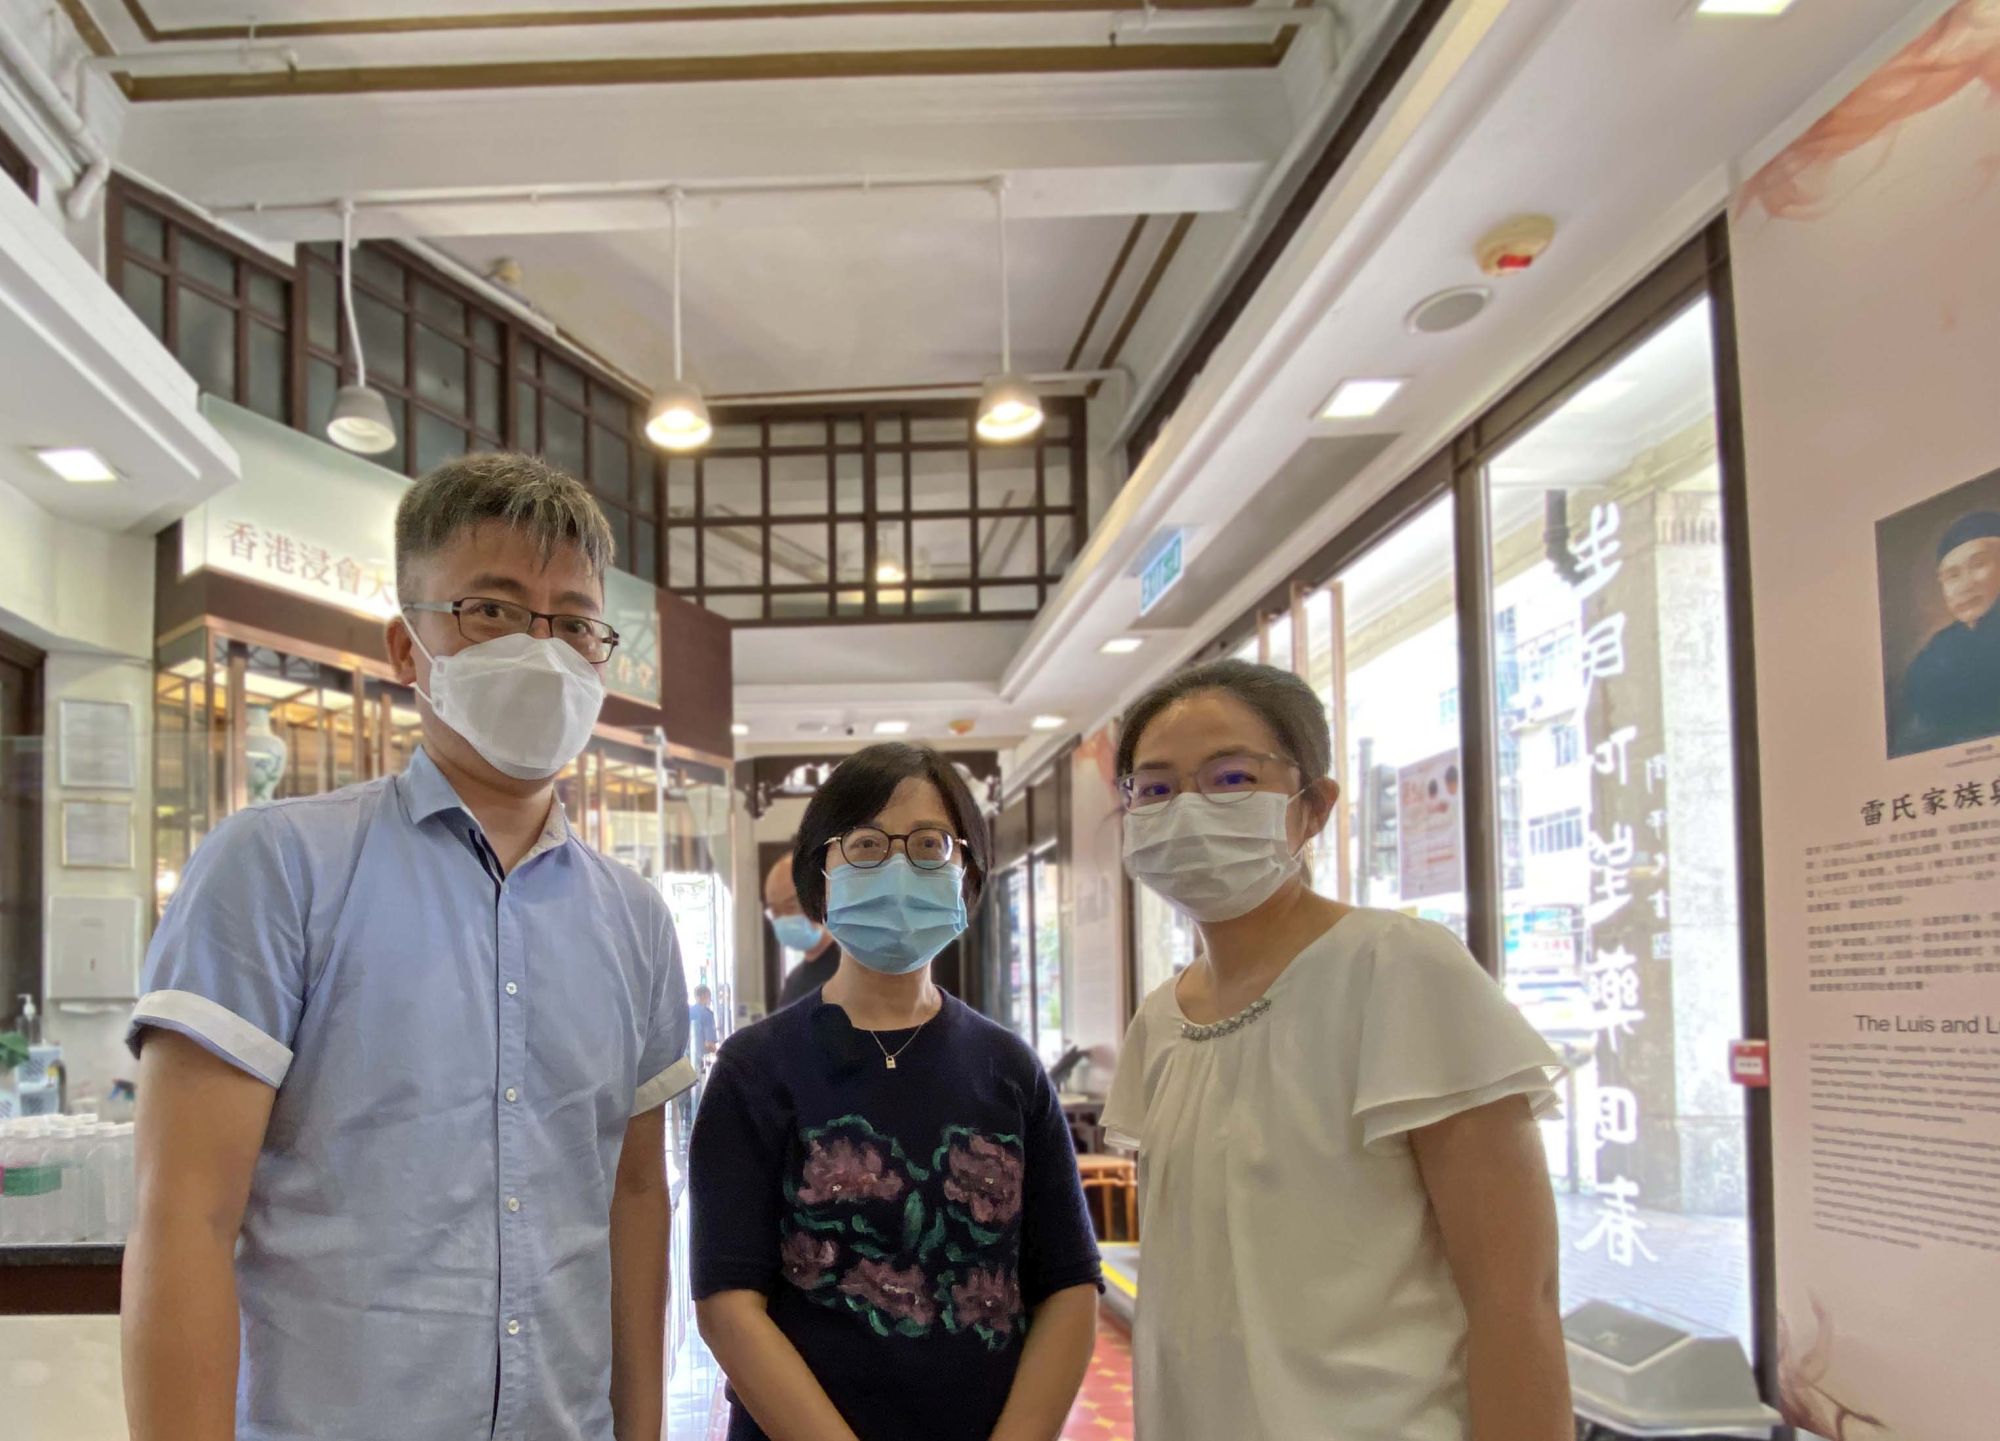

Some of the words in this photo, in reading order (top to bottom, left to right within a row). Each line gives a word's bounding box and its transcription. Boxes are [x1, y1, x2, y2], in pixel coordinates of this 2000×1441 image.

[1855, 1014, 1890, 1032] The
[1896, 1015, 1936, 1033] Luis
[1941, 1015, 1979, 1034] and
[1986, 1015, 2000, 1035] L
